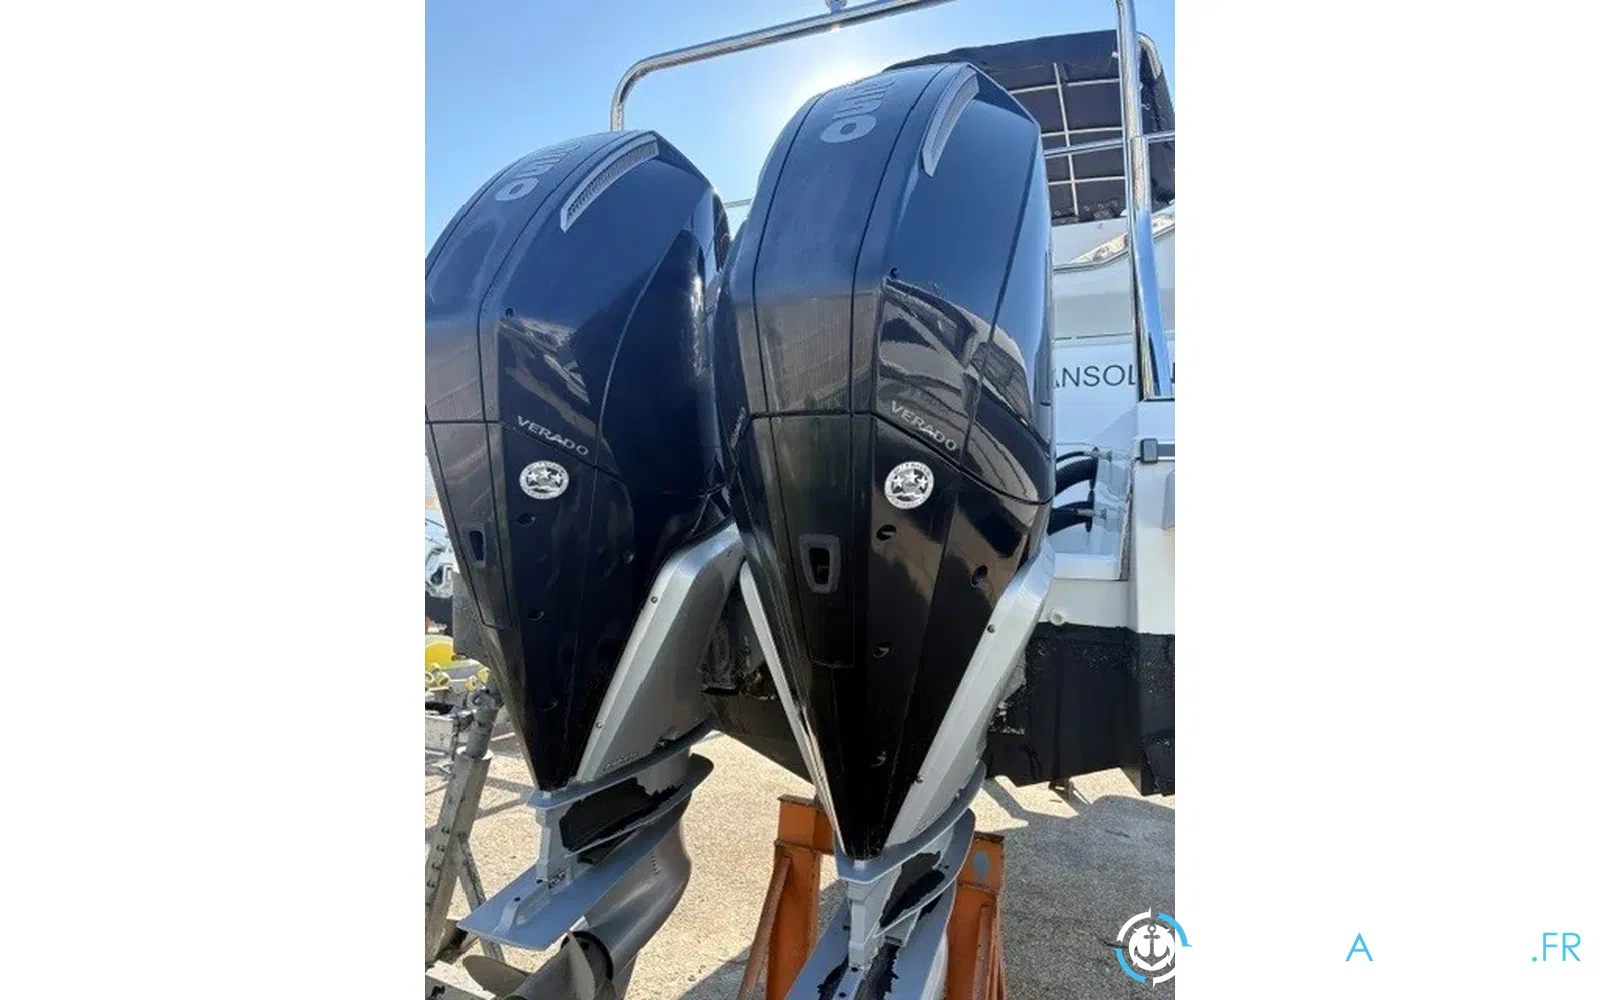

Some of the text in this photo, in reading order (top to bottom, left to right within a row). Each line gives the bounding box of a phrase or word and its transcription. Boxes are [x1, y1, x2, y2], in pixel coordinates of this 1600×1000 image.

[1055, 364, 1136, 388] NSOL
[517, 415, 590, 456] VERADO
[890, 400, 958, 451] VERADO
